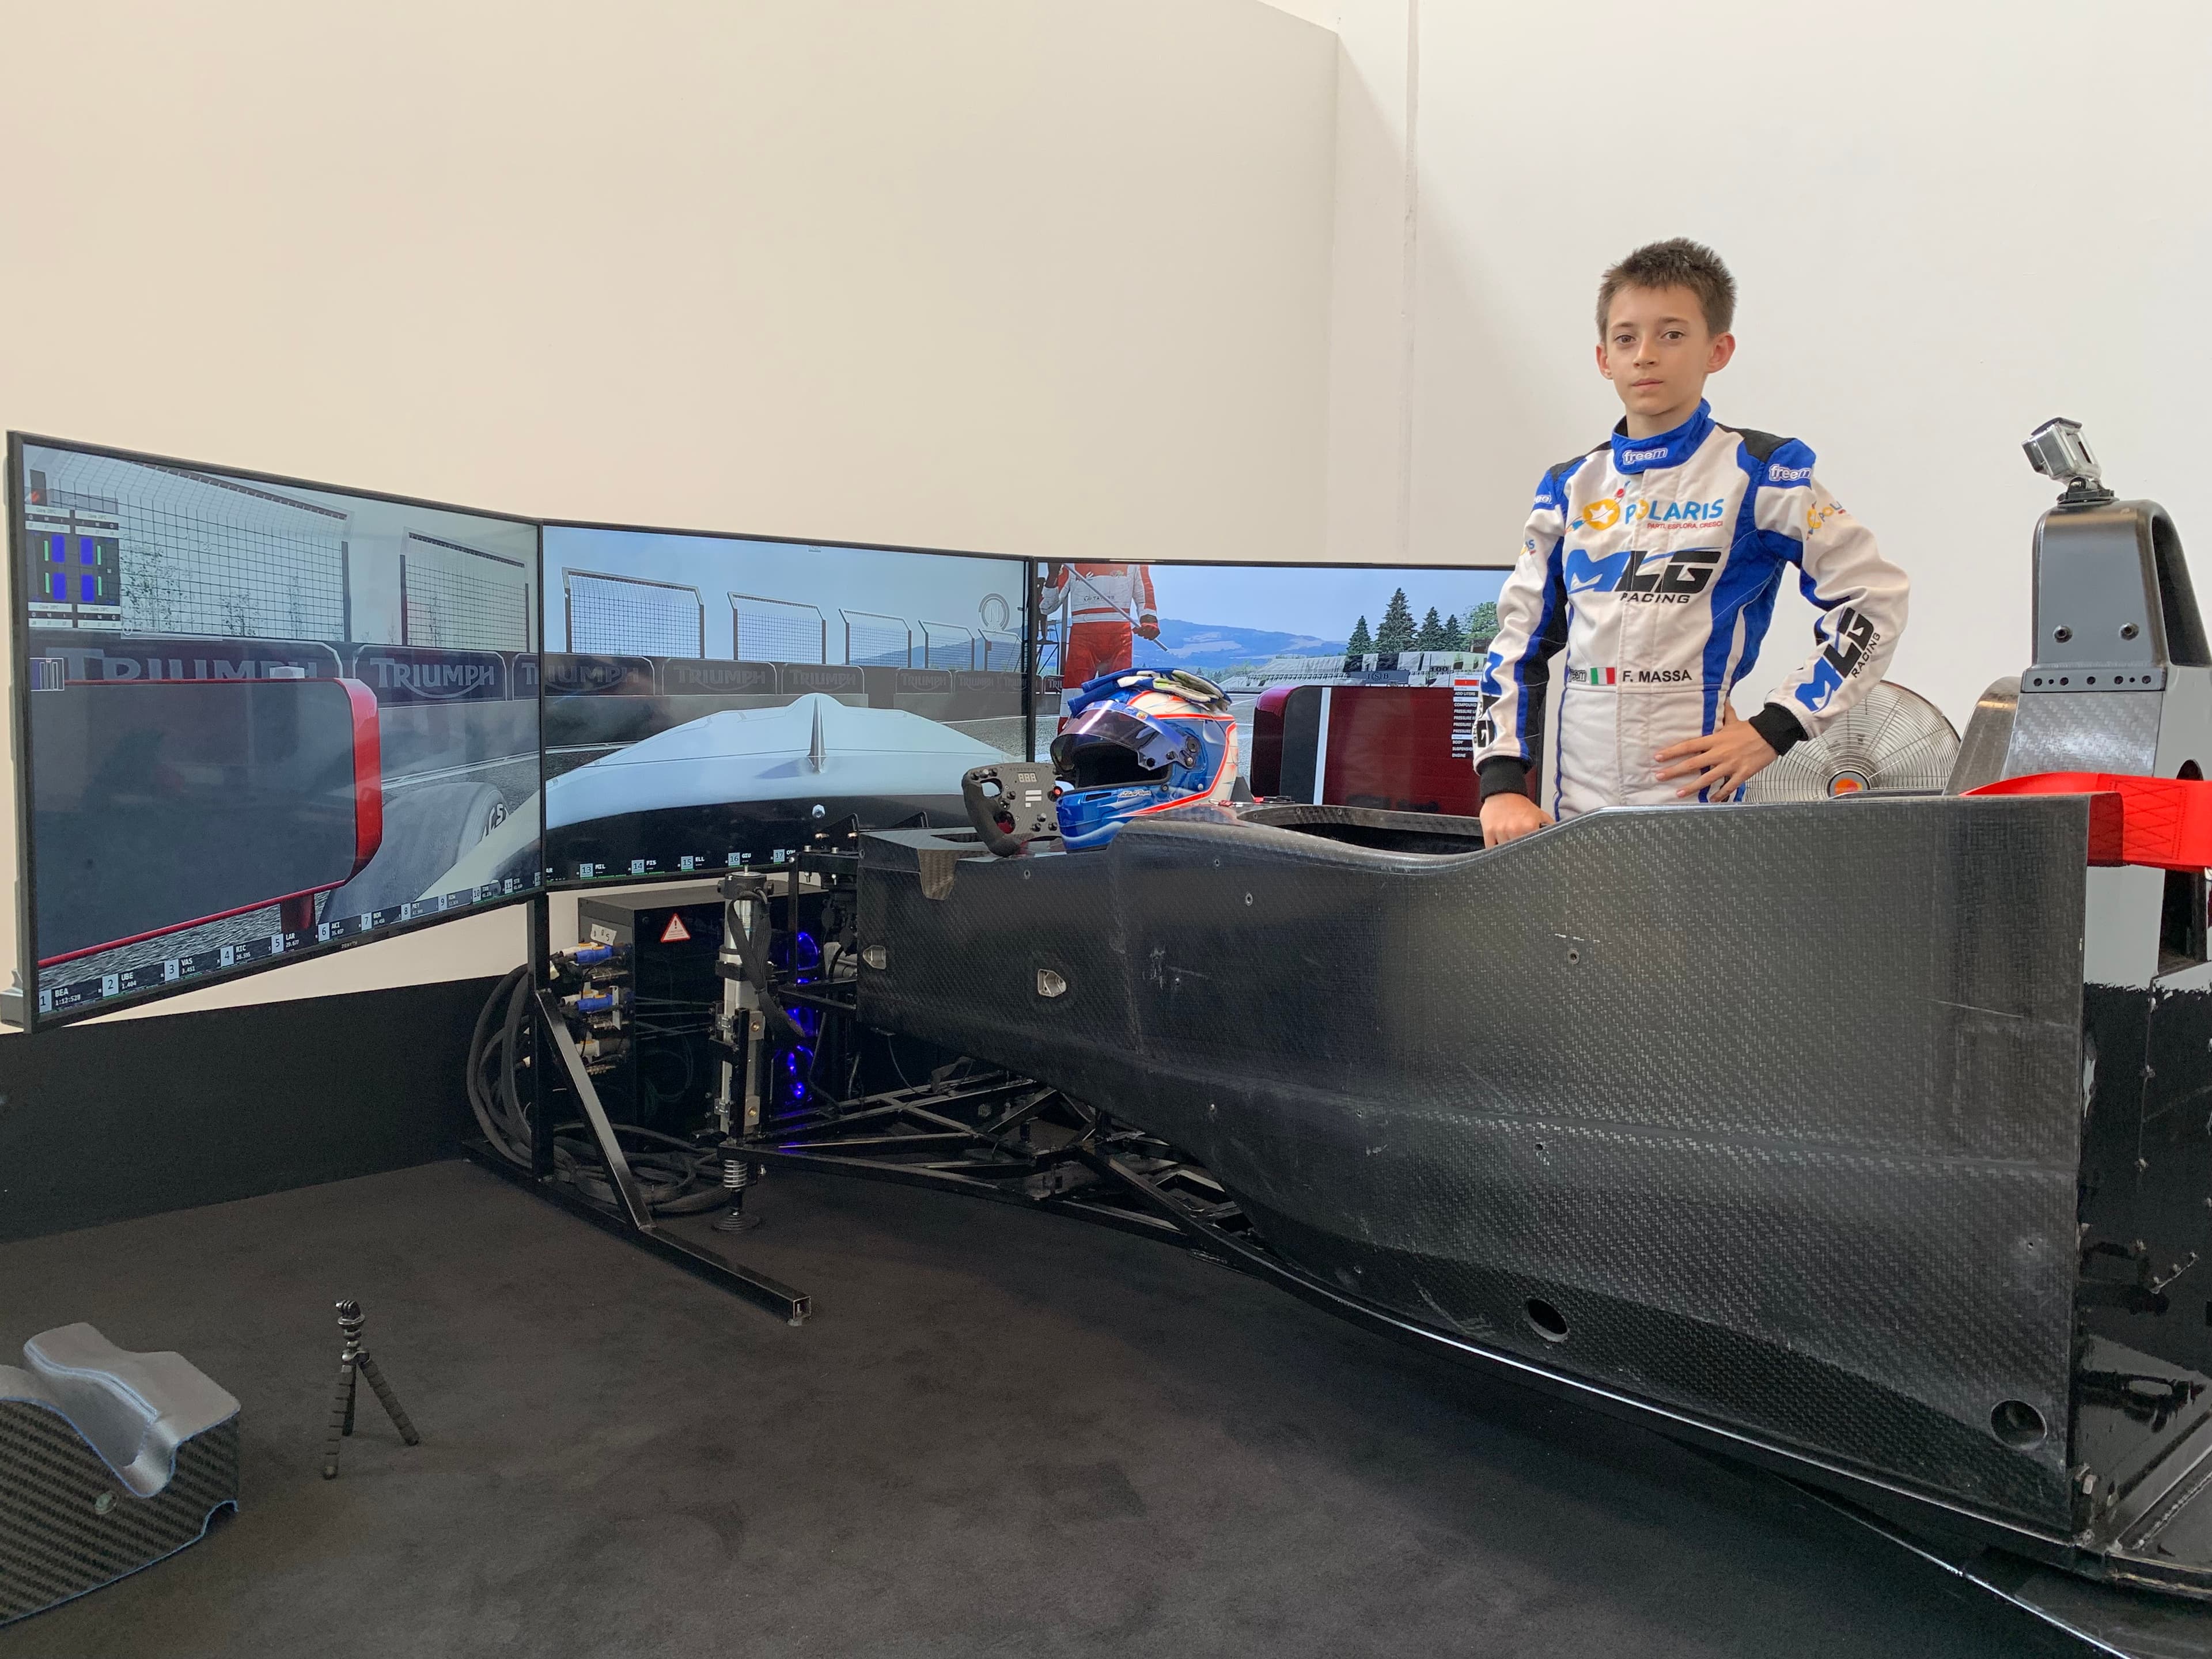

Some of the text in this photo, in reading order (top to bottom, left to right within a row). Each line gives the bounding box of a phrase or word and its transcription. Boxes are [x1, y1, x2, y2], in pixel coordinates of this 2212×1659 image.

[1623, 448, 1667, 464] freem
[1769, 464, 1812, 480] freem
[1625, 499, 1724, 524] POLARIS
[1851, 632, 1881, 679] RACING
[369, 658, 494, 694] TRIUMPH
[673, 665, 766, 689] TRIUMPH
[790, 669, 857, 689] TRIUMPH
[902, 672, 946, 690] TRIUMPH
[1623, 670, 1692, 683] F. MASSA
[506, 881, 512, 890] 11
[474, 889, 480, 898] 10
[441, 898, 444, 906] 9
[365, 916, 369, 925] 7
[322, 927, 326, 935] 6
[275, 938, 280, 947] 5
[225, 950, 230, 960] 4
[181, 958, 192, 966] VAS
[169, 964, 175, 974] 3
[121, 972, 134, 981] UBE
[108, 979, 114, 990] 2
[122, 980, 137, 989] 1.404
[55, 988, 69, 997] BEA
[40, 995, 46, 1006] 1
